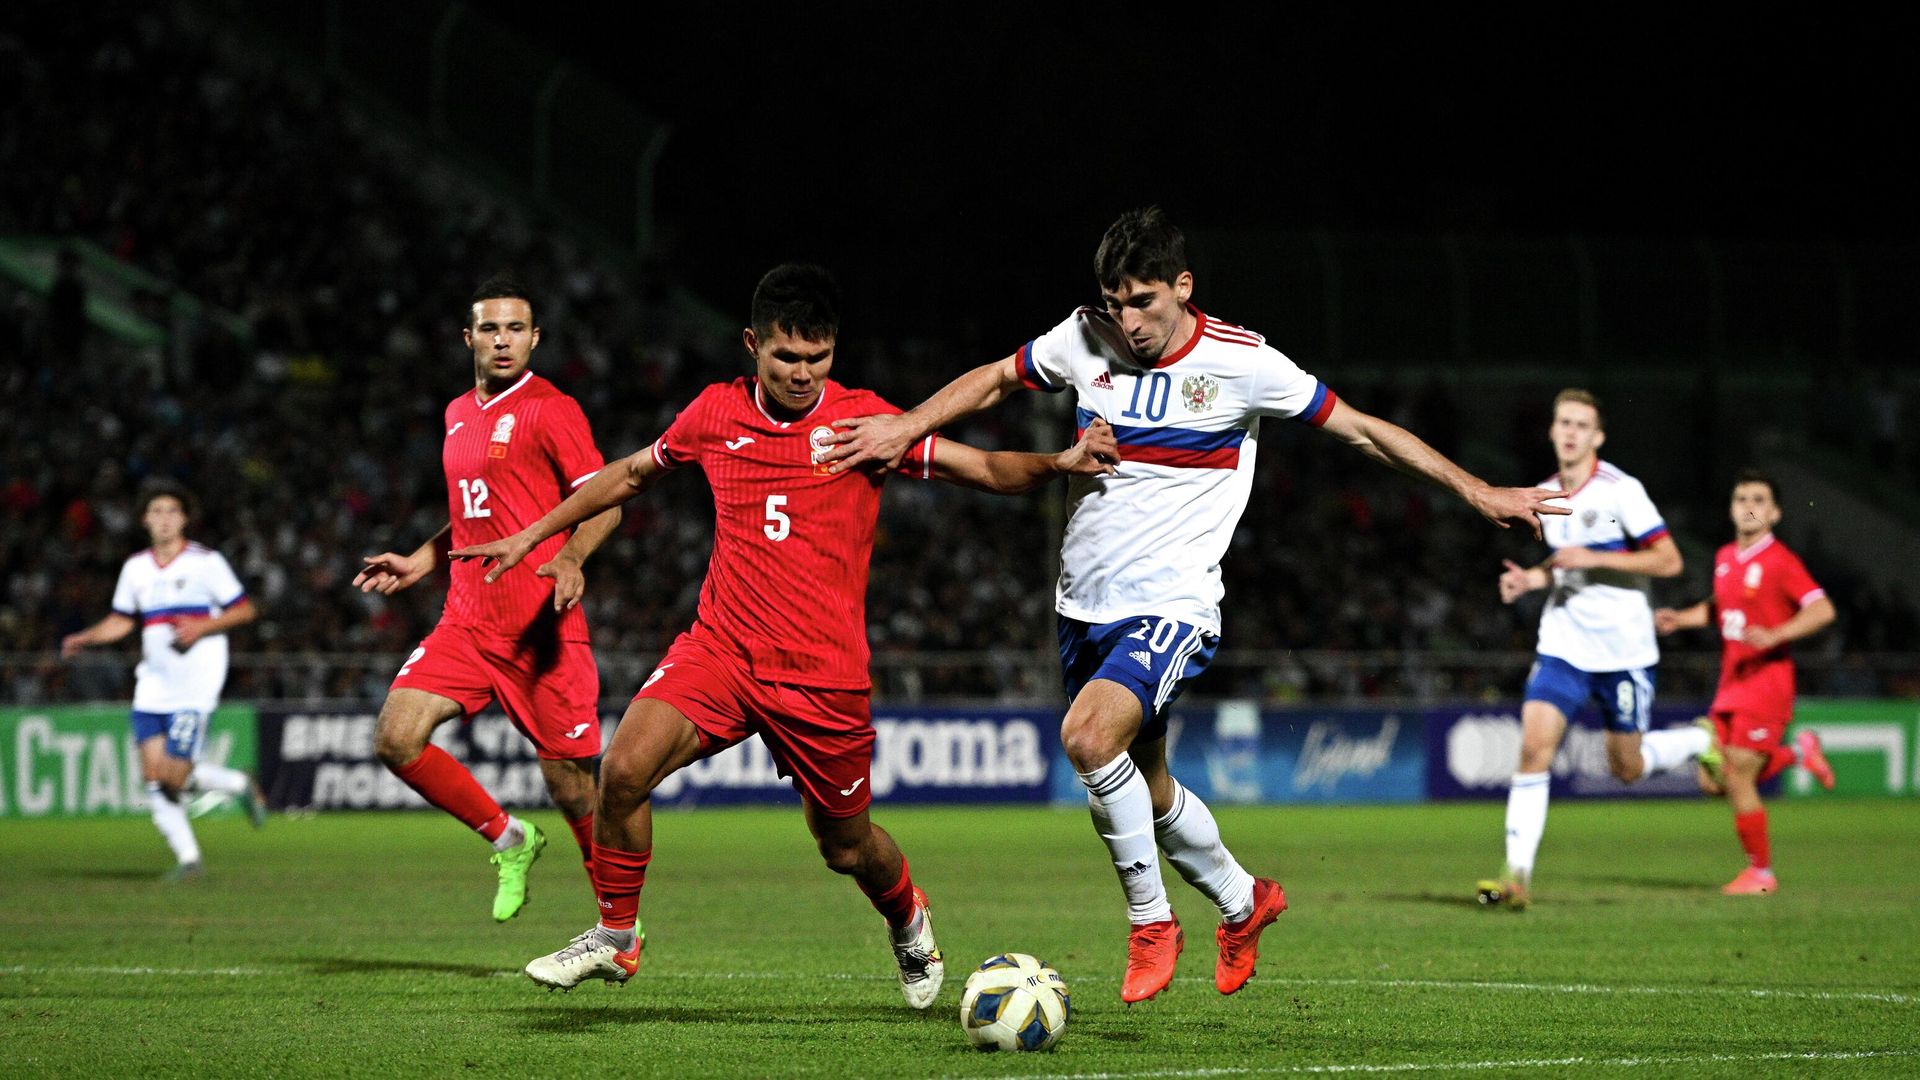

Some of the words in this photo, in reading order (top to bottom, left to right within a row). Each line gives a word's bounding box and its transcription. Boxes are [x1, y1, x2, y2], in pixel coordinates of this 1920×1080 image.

[1090, 379, 1115, 391] adidas
[1121, 371, 1171, 422] 10
[458, 478, 491, 519] 12
[763, 495, 791, 542] 5
[869, 717, 1048, 797] joma
